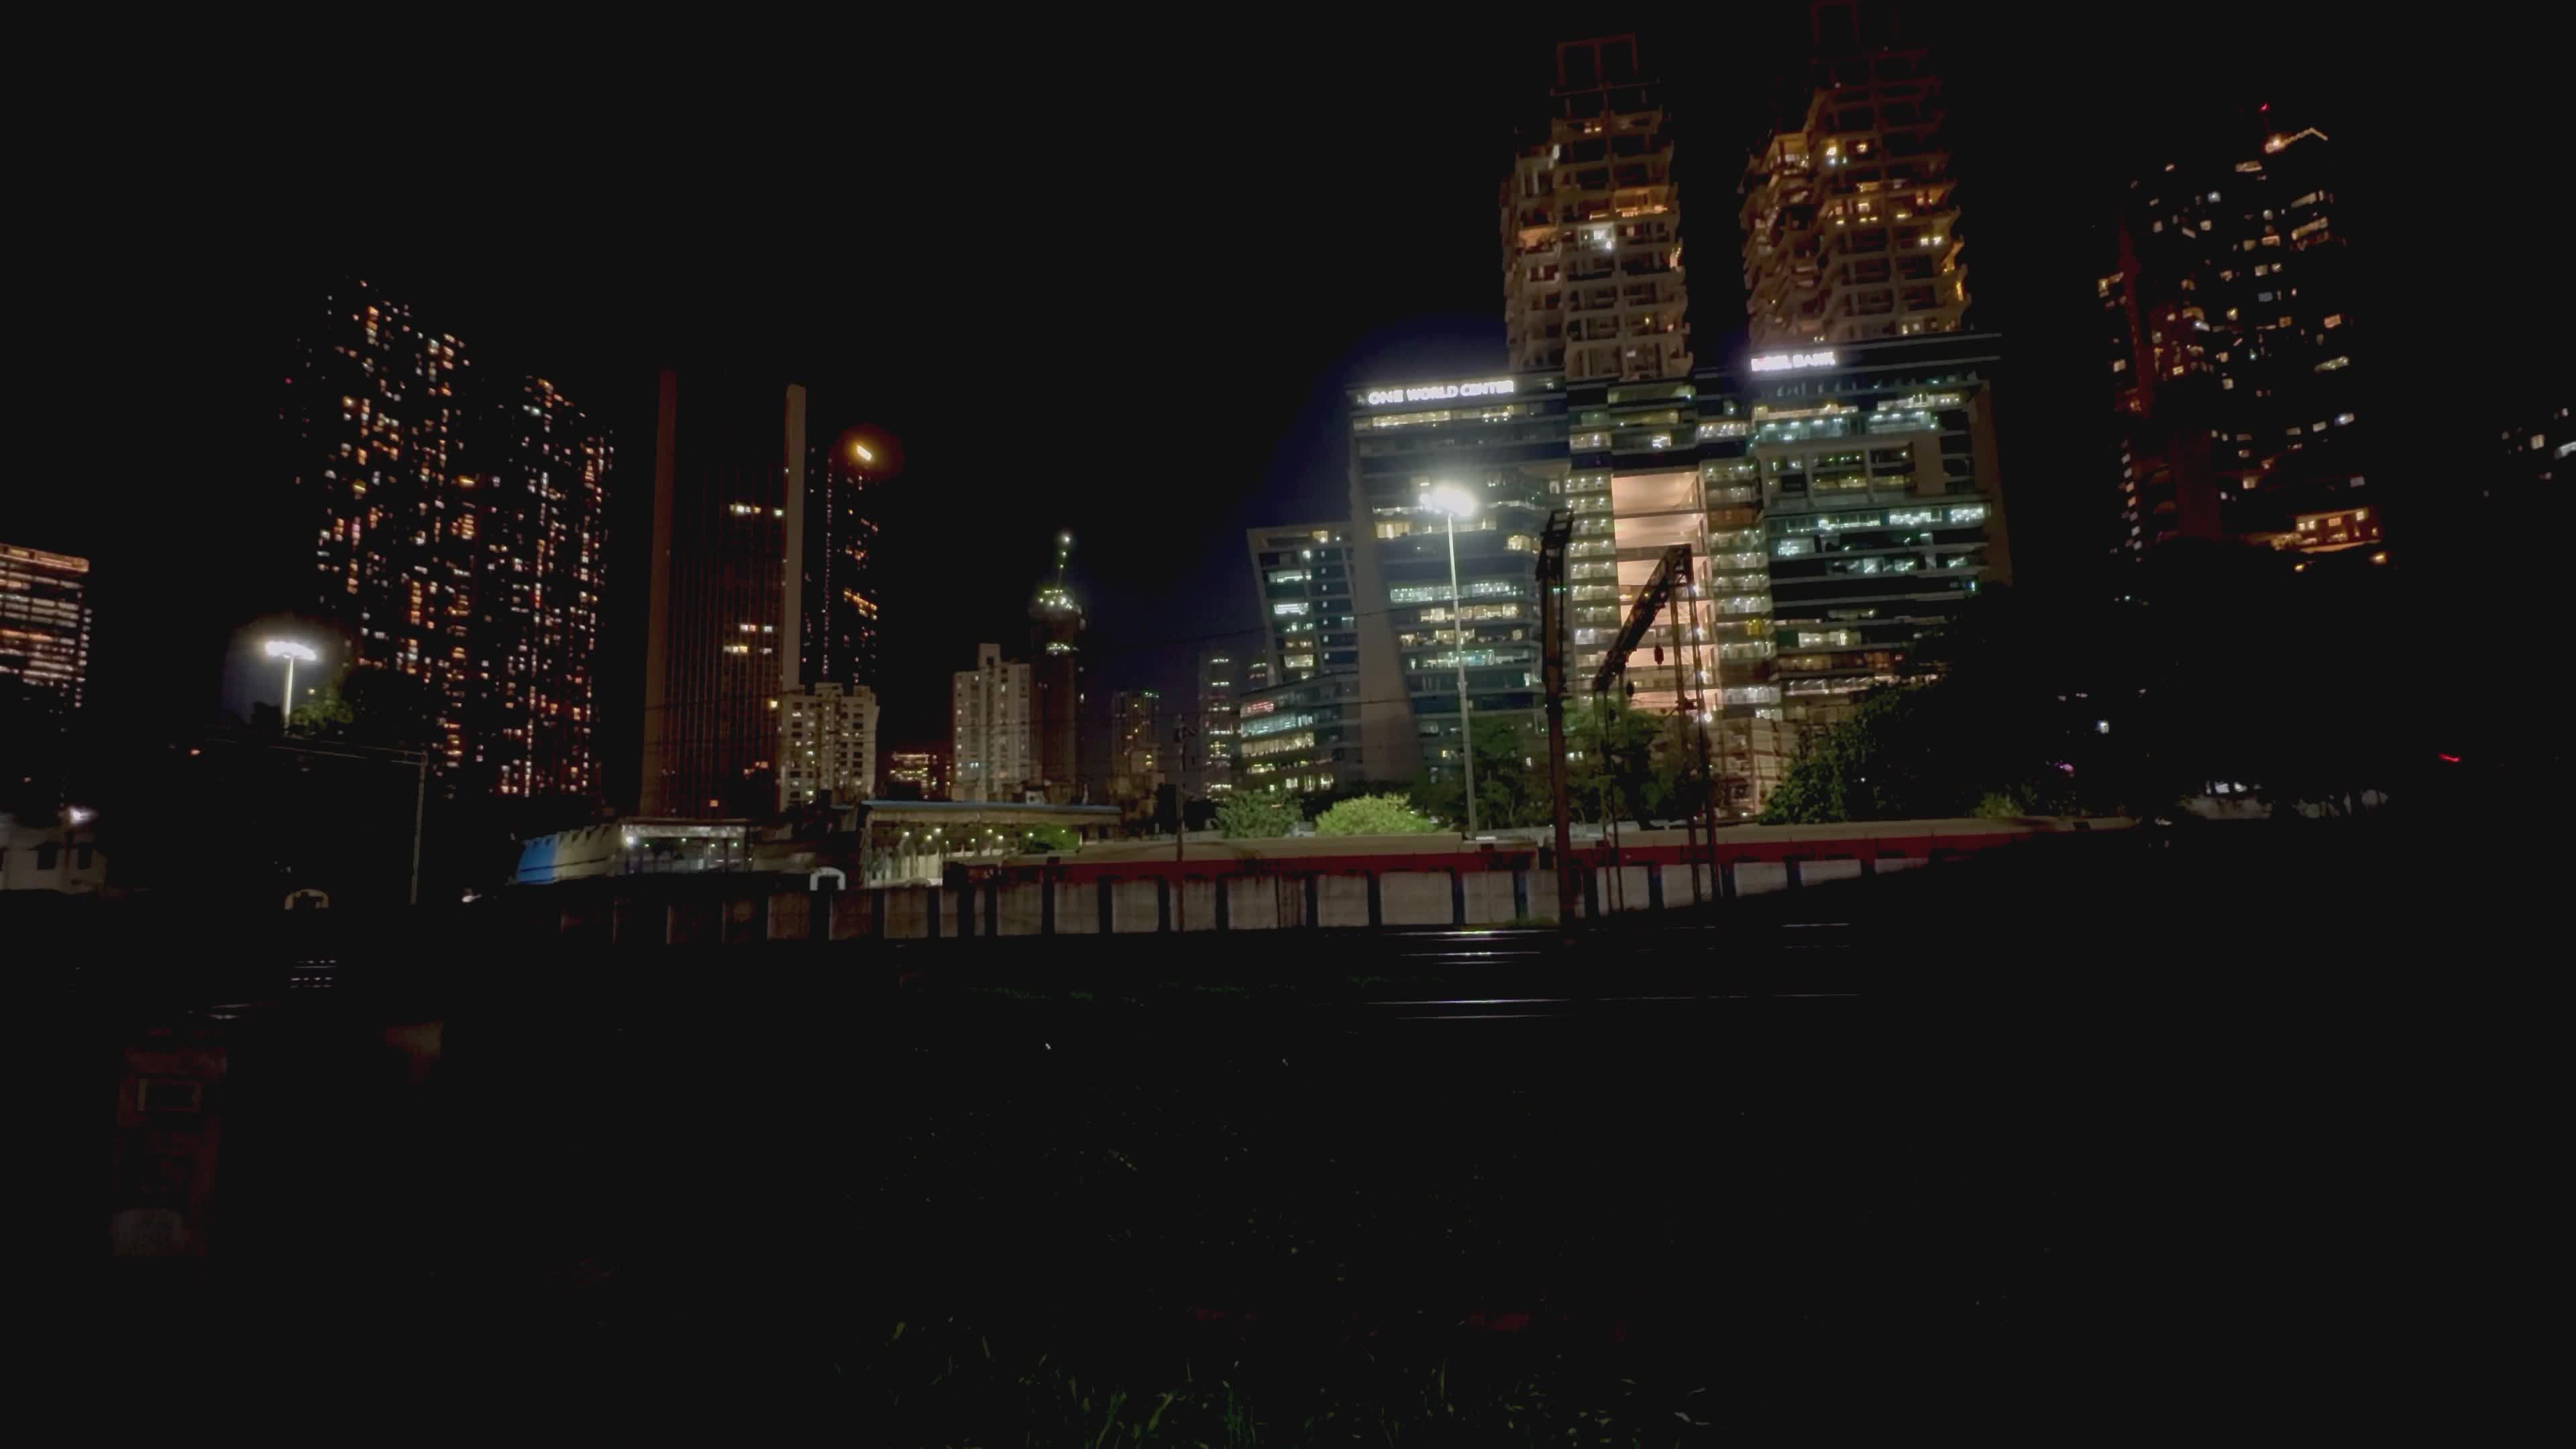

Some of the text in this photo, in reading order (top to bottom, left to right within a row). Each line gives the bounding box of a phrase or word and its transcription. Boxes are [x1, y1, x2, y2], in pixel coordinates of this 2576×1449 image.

[1792, 352, 1835, 368] BANK
[1368, 380, 1514, 405] ONE WORLD CENTER
